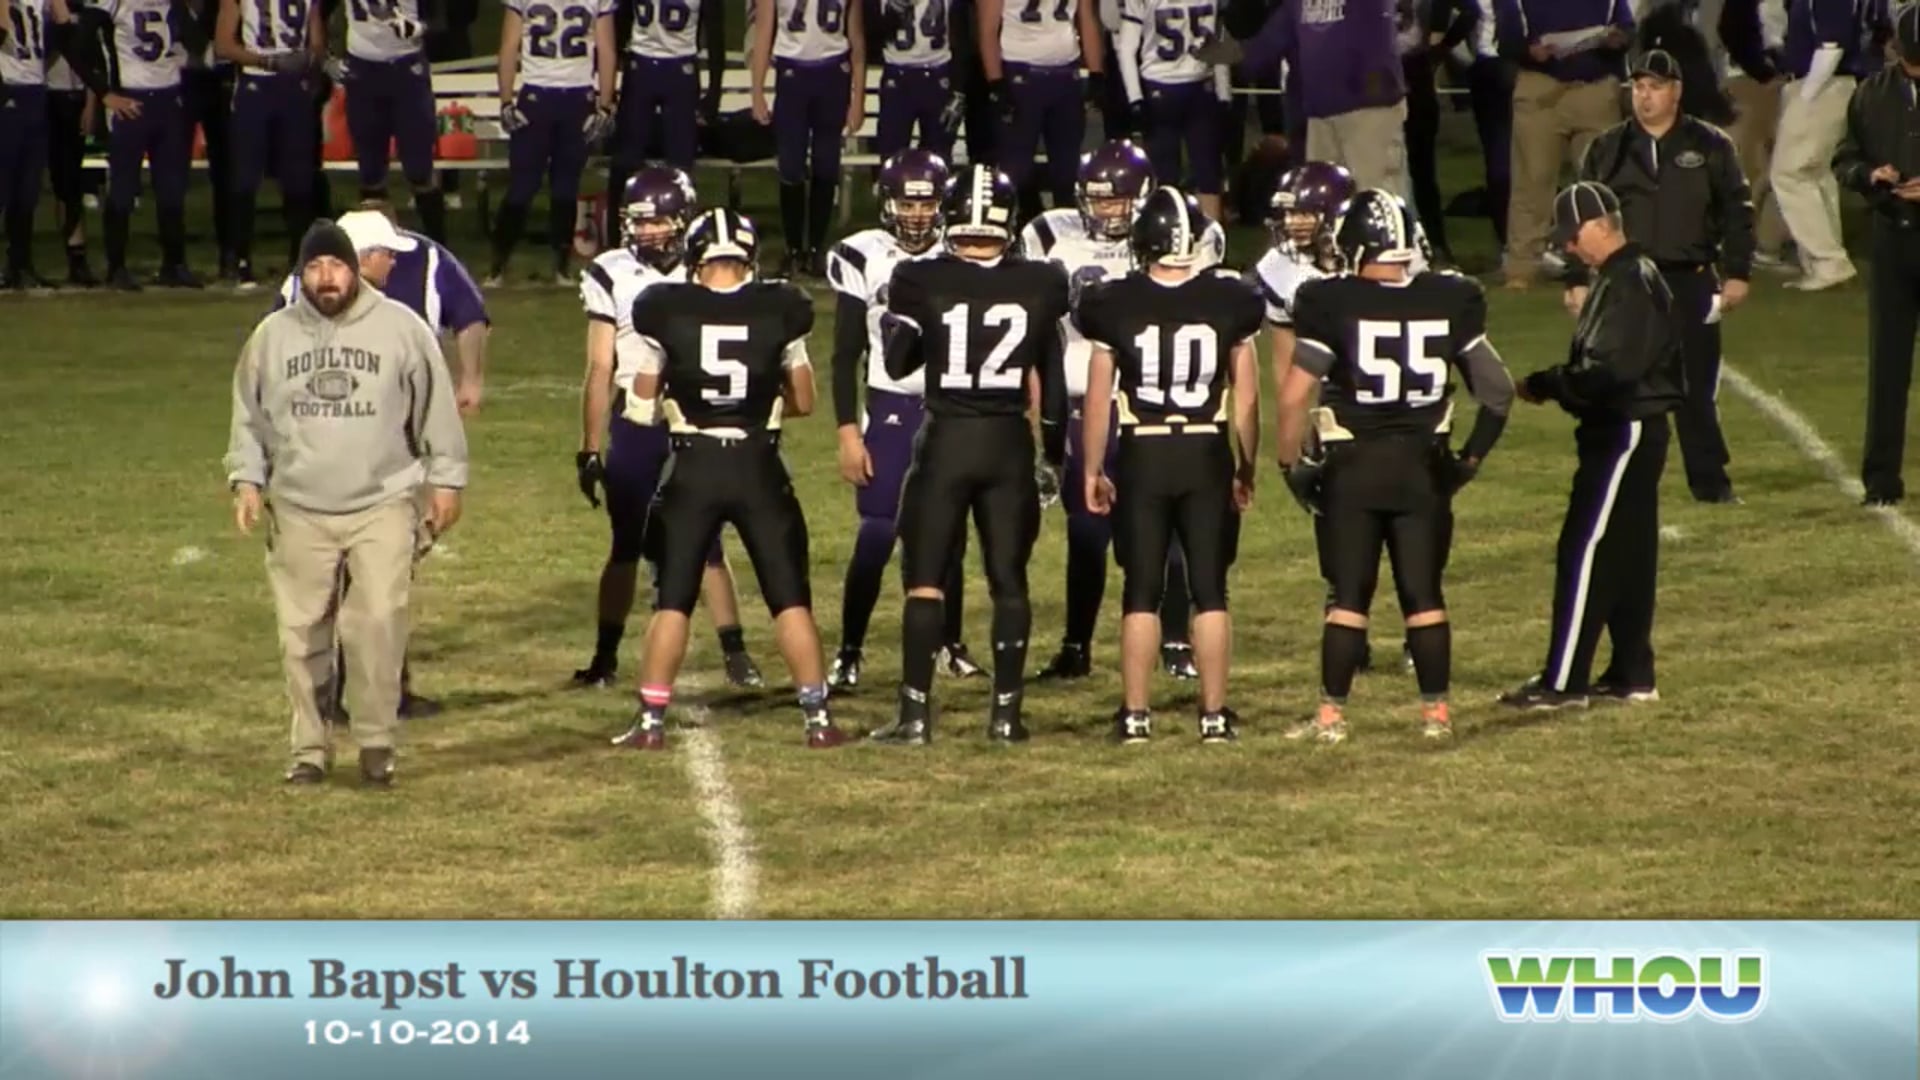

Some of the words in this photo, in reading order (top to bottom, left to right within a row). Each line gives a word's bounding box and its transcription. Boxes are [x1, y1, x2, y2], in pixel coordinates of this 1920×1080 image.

[527, 4, 592, 58] 22
[1154, 4, 1214, 61] 55
[286, 346, 381, 379] HOULTON
[700, 324, 749, 402] 5
[940, 303, 1028, 389] 12
[1134, 323, 1218, 408] 10
[1356, 319, 1450, 408] 55
[291, 401, 376, 418] FOOTBALL
